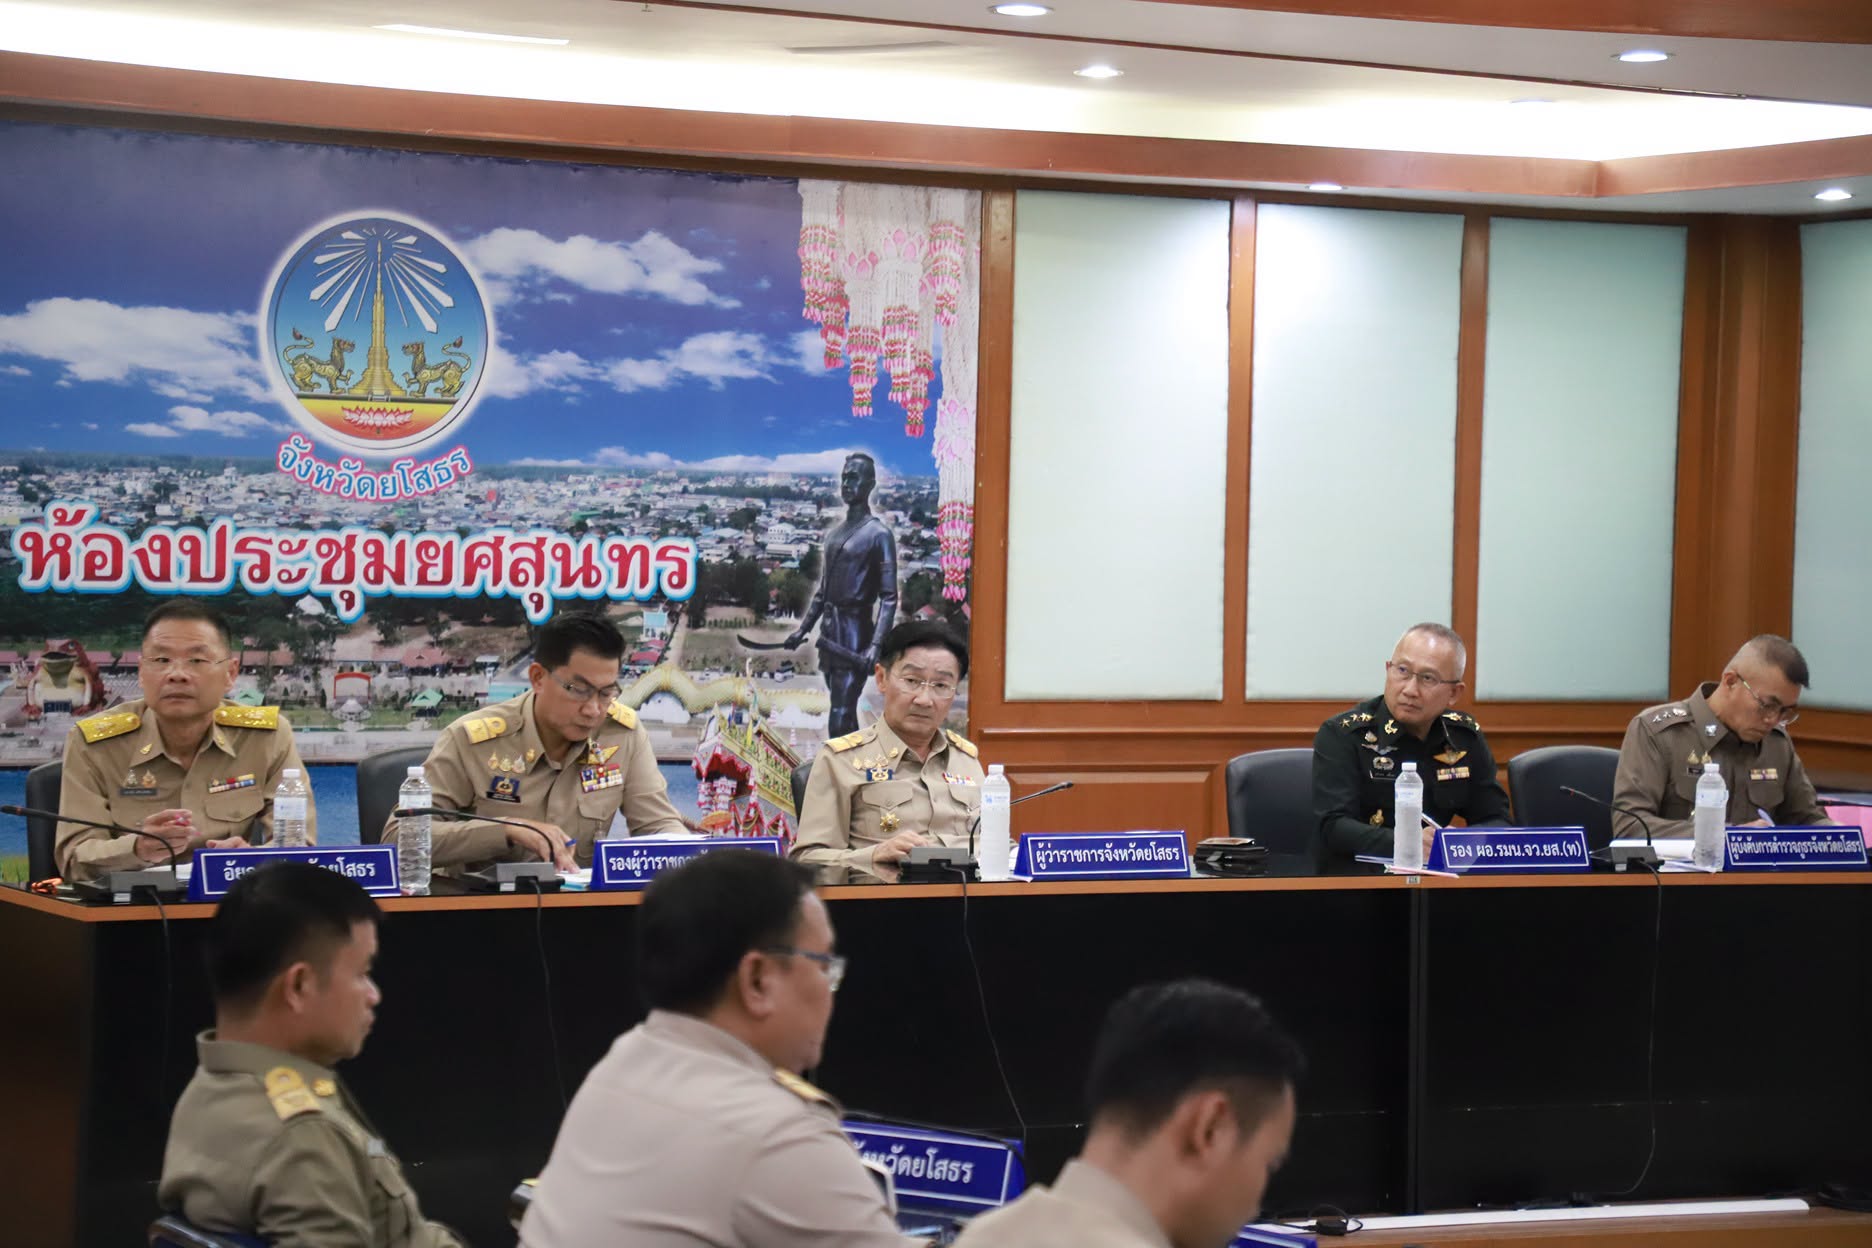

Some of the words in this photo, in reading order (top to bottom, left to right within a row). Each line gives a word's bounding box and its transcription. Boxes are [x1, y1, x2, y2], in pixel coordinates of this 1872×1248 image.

[278, 436, 471, 499] จังหวัดยโสธร
[18, 506, 695, 617] ห้องประชุมยศสุนทร
[1036, 841, 1180, 870] ผู้ว่าราชการจังหวัดยโสธร
[1450, 843, 1473, 858] รอง
[1476, 840, 1582, 858] ผอ.รมน.จว.ยส.(ท)
